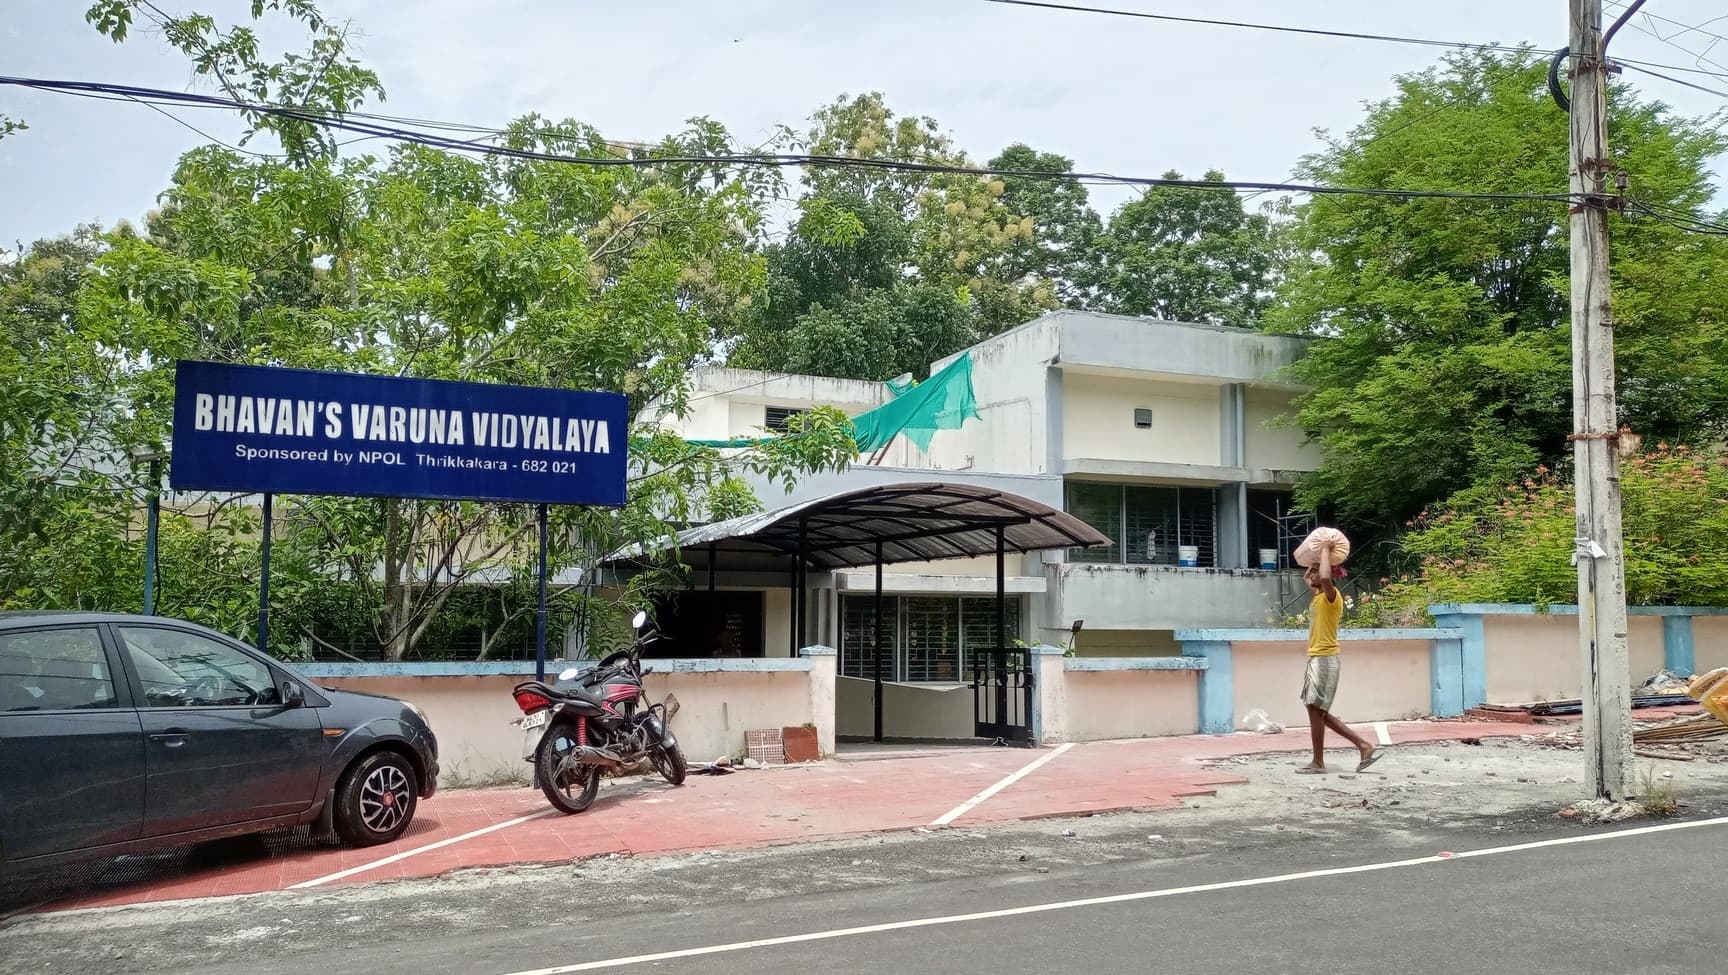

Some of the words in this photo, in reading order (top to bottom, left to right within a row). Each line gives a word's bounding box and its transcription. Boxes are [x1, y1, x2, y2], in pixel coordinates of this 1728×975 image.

[194, 393, 344, 439] BHAVAN'S
[350, 403, 465, 447] VARUNA
[472, 411, 610, 454] VIDYALAYA
[235, 444, 328, 463] Sponsored
[333, 449, 353, 467] by
[359, 450, 406, 465] NPOL
[415, 453, 508, 471] Thrikkakara
[521, 459, 548, 473] 682
[552, 461, 577, 474] 021
